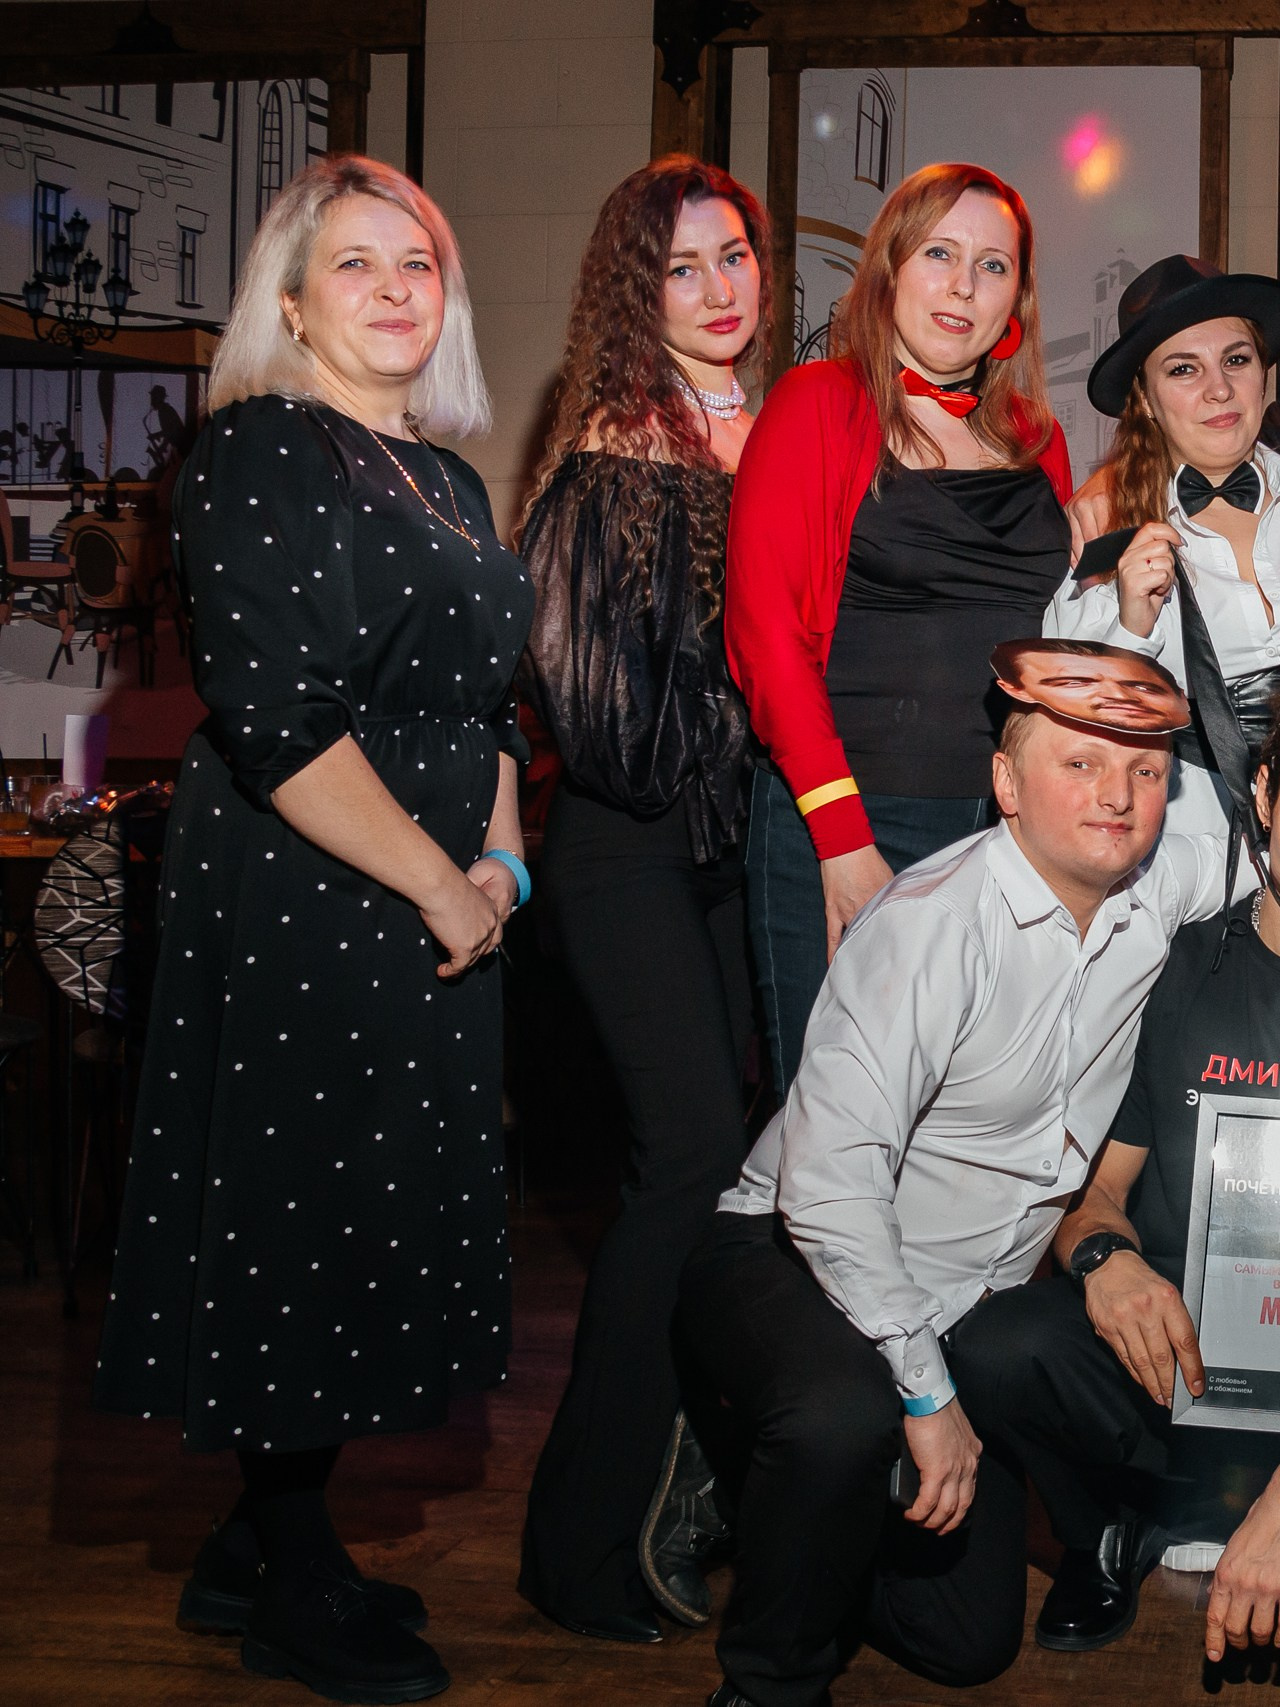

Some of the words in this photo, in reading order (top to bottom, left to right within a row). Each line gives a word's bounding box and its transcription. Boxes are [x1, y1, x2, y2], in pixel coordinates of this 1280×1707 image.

[1234, 1262, 1280, 1277] САМЫЙ
[1208, 1375, 1215, 1383] С
[1215, 1376, 1248, 1386] любовью
[1214, 1385, 1253, 1394] обожанием
